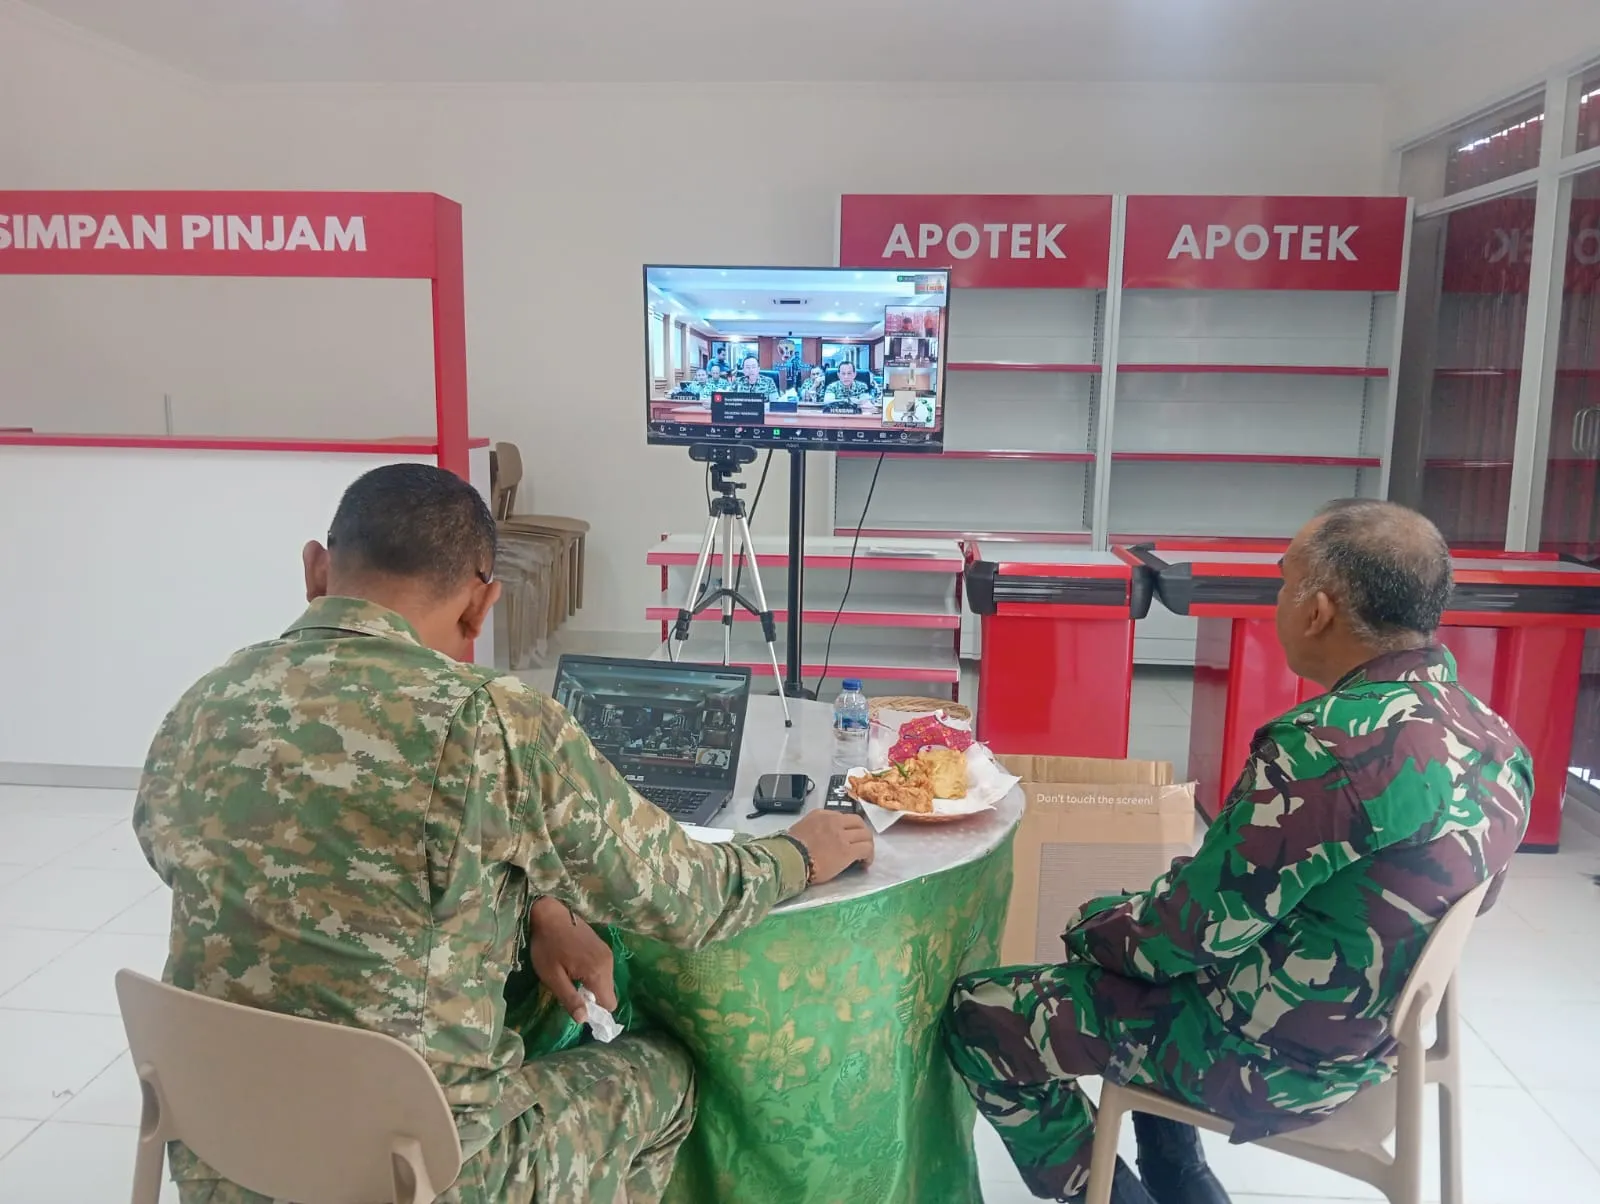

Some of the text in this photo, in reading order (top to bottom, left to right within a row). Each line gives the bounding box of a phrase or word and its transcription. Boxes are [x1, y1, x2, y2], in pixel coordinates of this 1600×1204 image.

[0, 214, 367, 252] SIMPAN PINJAM
[881, 223, 1068, 259] APOTEK
[1167, 224, 1360, 261] APOTEK
[1036, 793, 1154, 806] Don't touch the screen!
